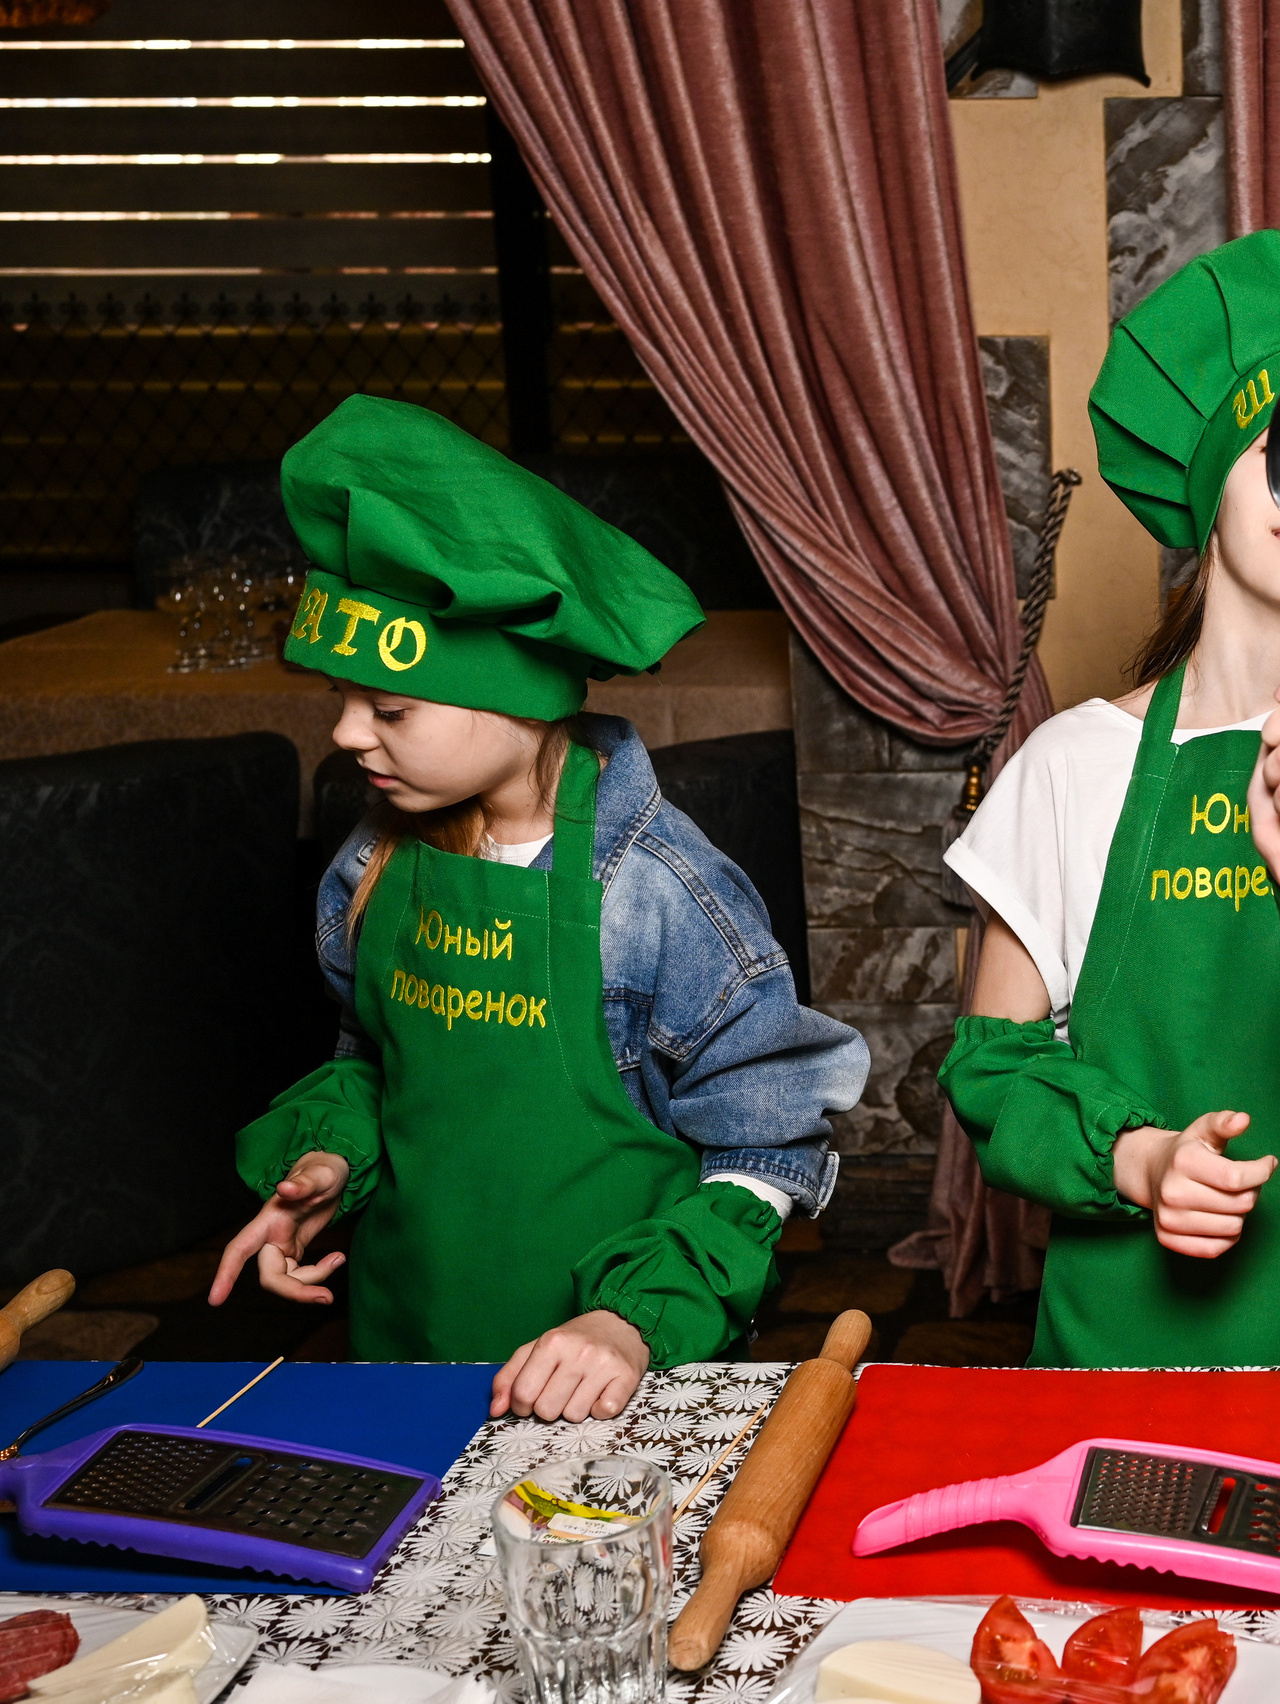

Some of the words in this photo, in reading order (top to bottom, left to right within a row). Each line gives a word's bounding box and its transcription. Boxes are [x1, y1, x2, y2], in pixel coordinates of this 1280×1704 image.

[290, 583, 427, 672] АТО
[1190, 792, 1250, 835] Юн
[1150, 864, 1272, 913] поваре
[414, 905, 513, 961] Юный
[390, 969, 547, 1031] поваренок
